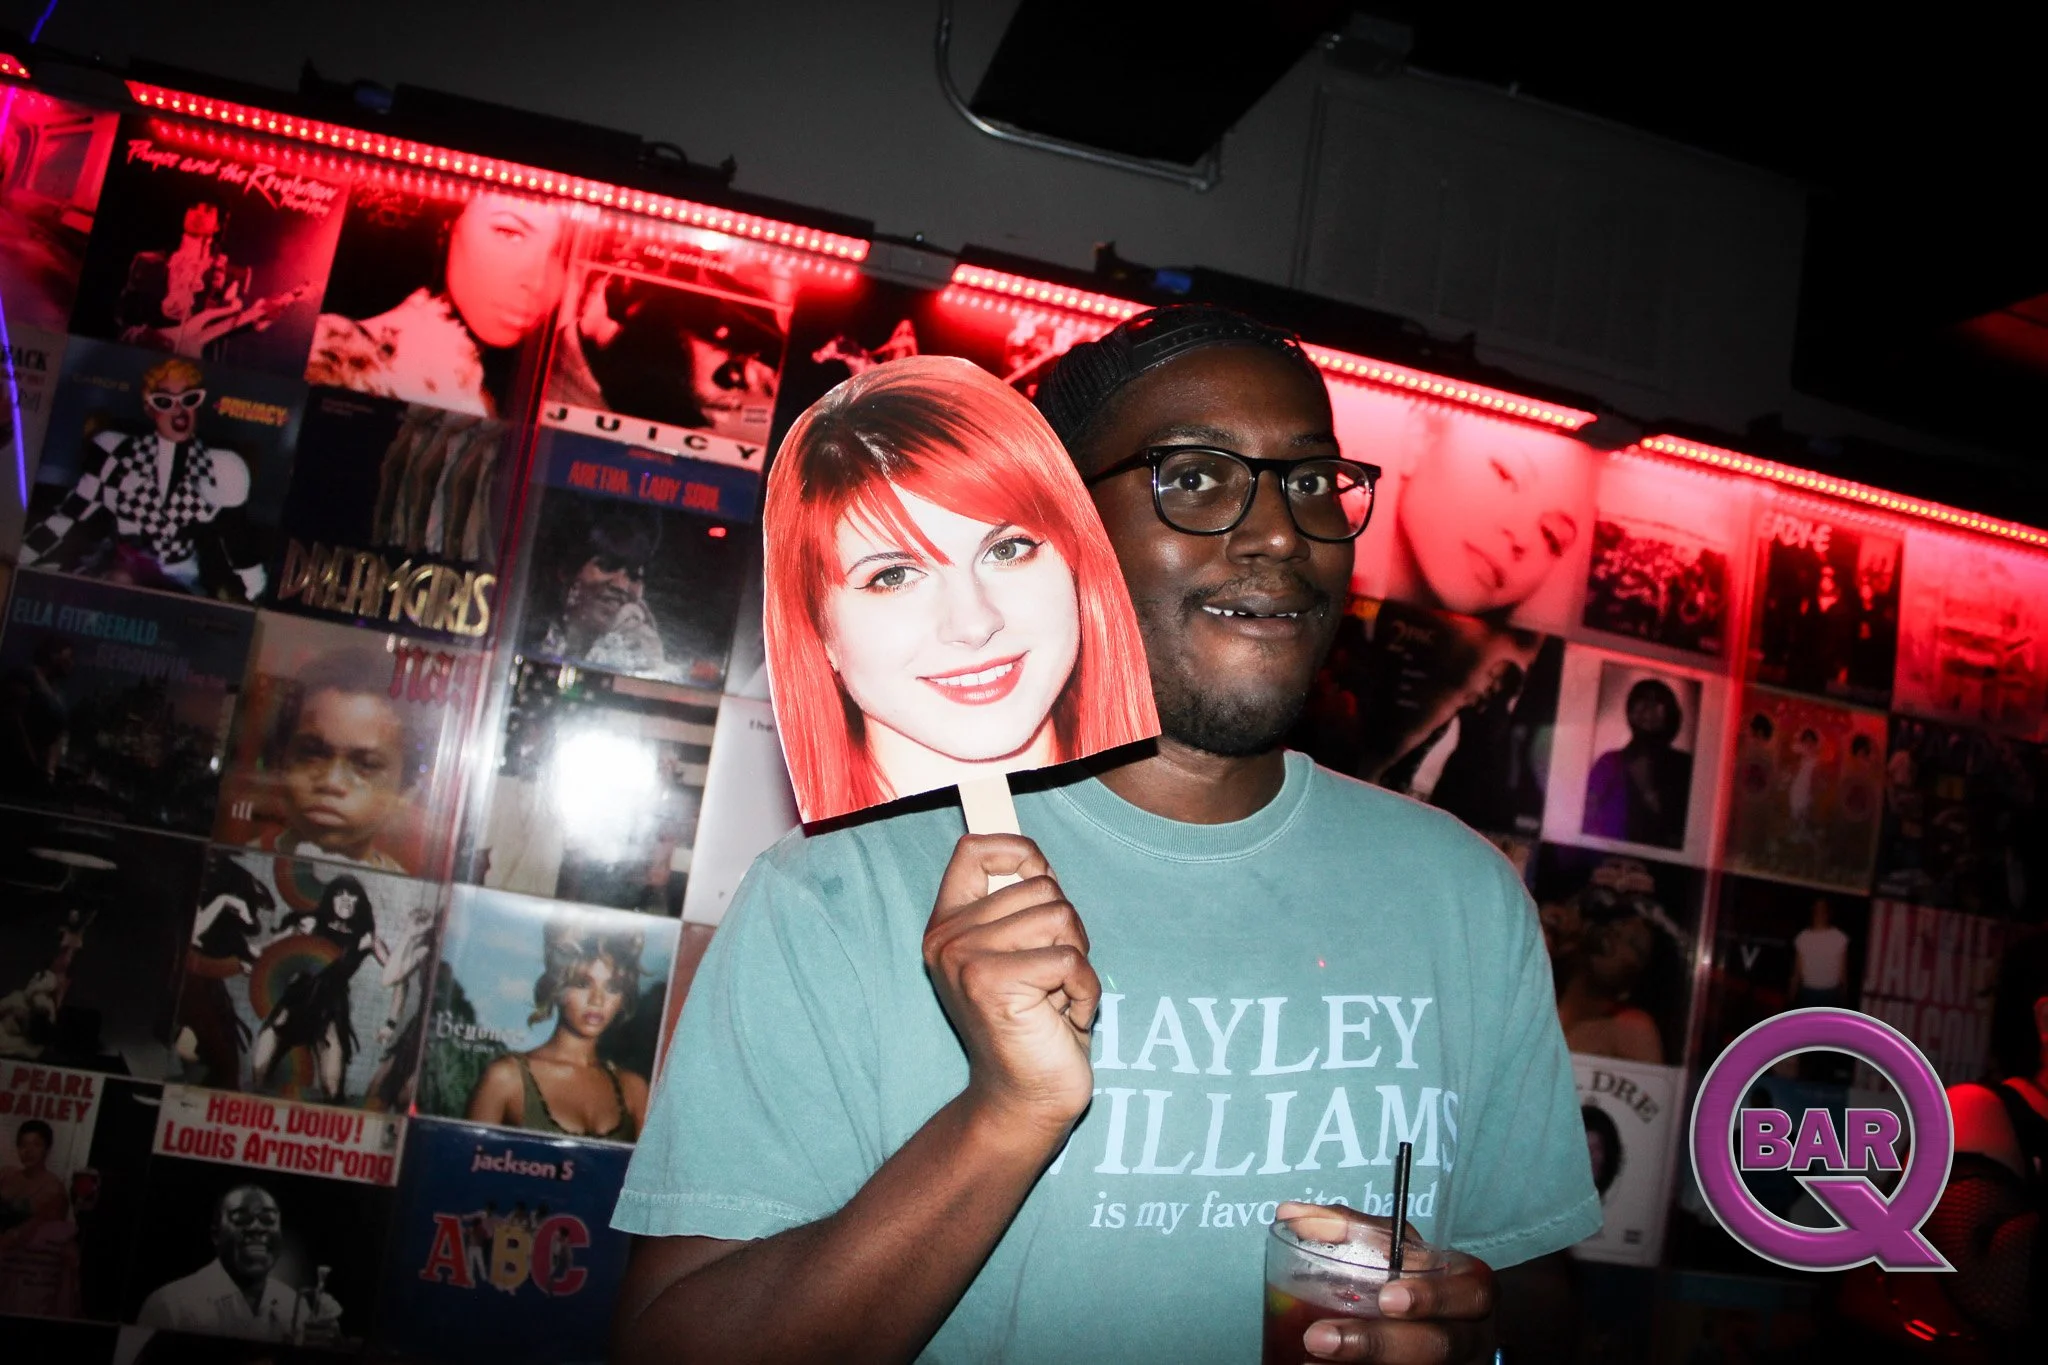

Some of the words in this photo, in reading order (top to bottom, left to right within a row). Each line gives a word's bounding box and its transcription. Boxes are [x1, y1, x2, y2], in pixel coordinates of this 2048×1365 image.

[178, 157, 222, 176] and
[217, 162, 250, 185] the
[213, 396, 289, 428] PRIVACY
[547, 407, 758, 460] JUICY
[638, 472, 682, 505] LADY
[681, 480, 722, 514] SOUL
[12, 597, 53, 626] ELLA
[56, 603, 159, 647] FITZGERALD
[435, 1009, 528, 1043] Beyon
[11, 1068, 94, 1098] PEARL
[1591, 1070, 1660, 1124] DRE
[0, 1091, 91, 1123] BAILEY
[287, 1106, 365, 1143] Dolly!
[1050, 1084, 1459, 1177] ILLIAMS
[162, 1121, 237, 1161] Louis
[242, 1133, 395, 1184] Armstrong
[470, 1145, 558, 1179] jackson
[559, 1159, 575, 1181] 5
[1089, 1191, 1127, 1229] is
[1134, 1200, 1190, 1235] my
[1198, 1190, 1349, 1228] favoi
[418, 1211, 592, 1297] ABC
